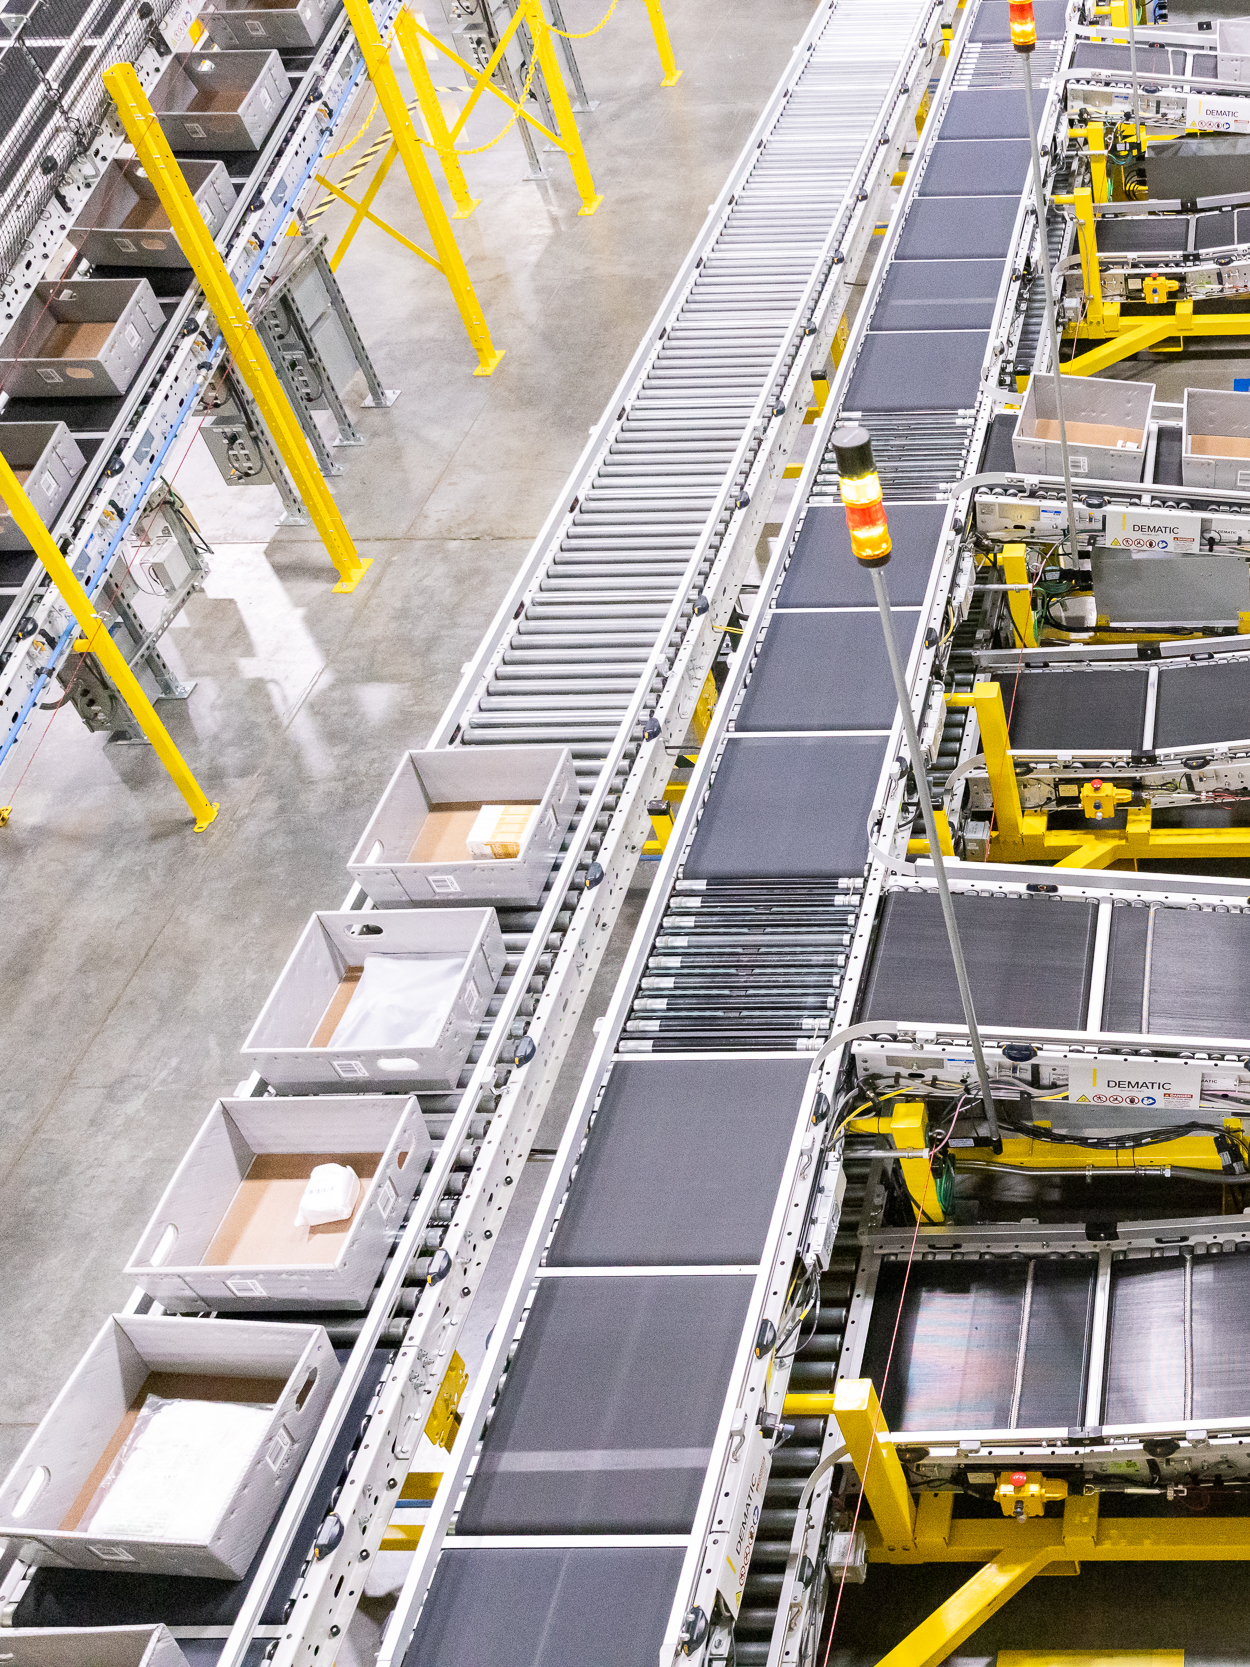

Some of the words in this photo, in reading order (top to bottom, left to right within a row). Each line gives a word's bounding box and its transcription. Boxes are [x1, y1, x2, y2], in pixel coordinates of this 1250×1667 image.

[1205, 109, 1239, 118] DEMATIC
[1132, 524, 1180, 535] DEMATIC
[1107, 1079, 1172, 1091] DEMATIC
[735, 1473, 757, 1556] DEMATIC
